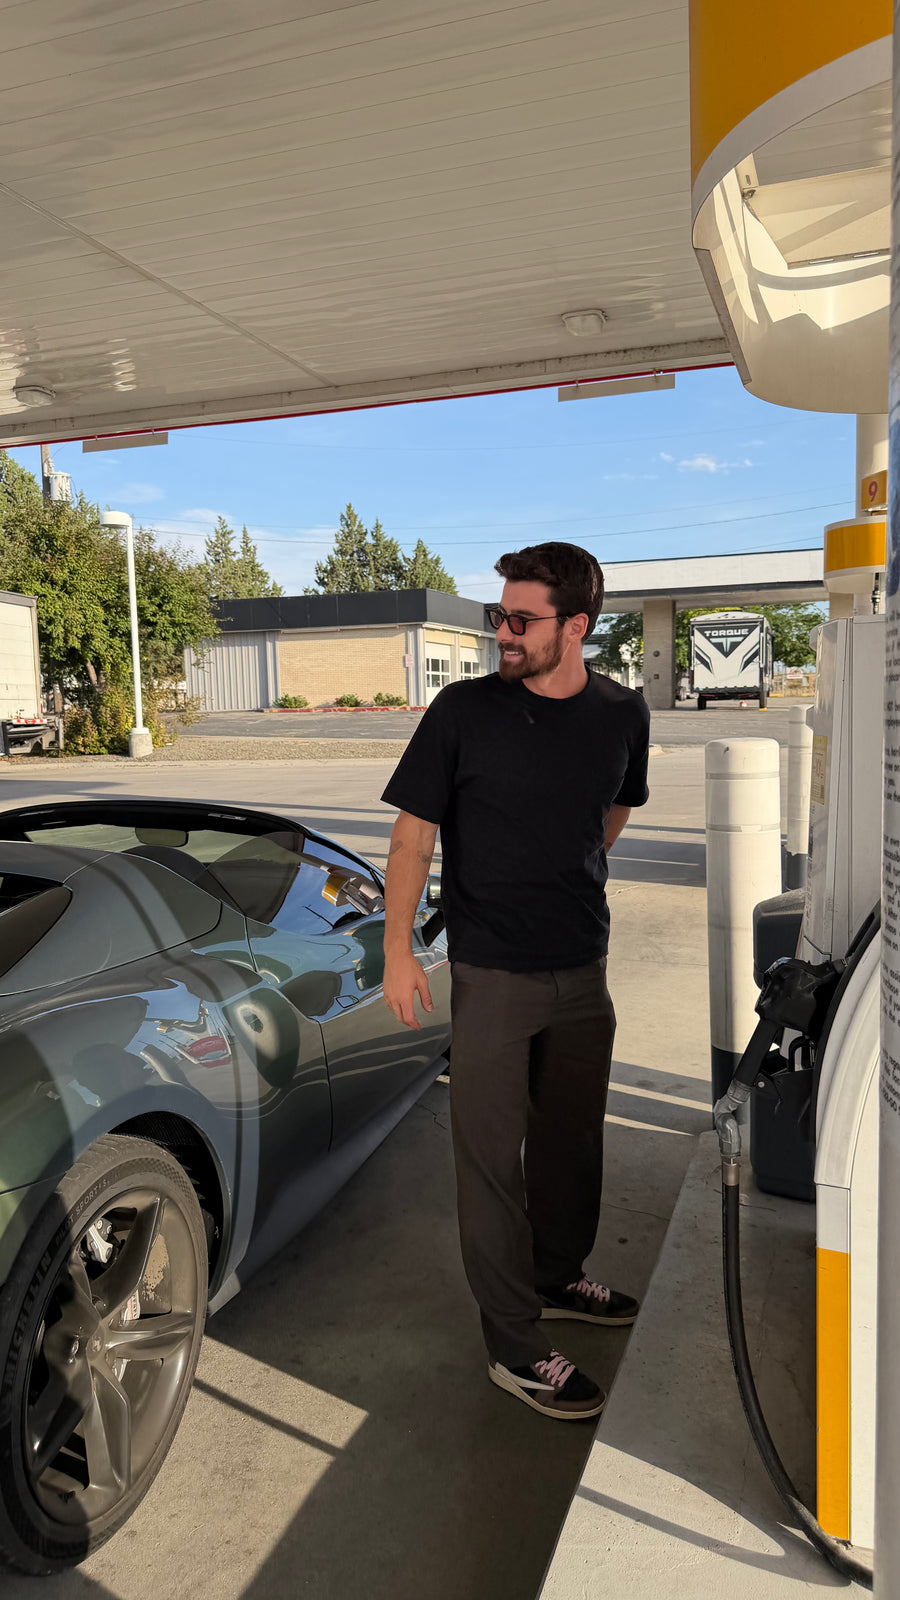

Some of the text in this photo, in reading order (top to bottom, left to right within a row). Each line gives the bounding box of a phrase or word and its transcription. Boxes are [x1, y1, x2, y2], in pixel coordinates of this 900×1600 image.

[868, 481, 877, 502] 9
[704, 628, 749, 637] TORQUE
[74, 1185, 99, 1215] SPORT
